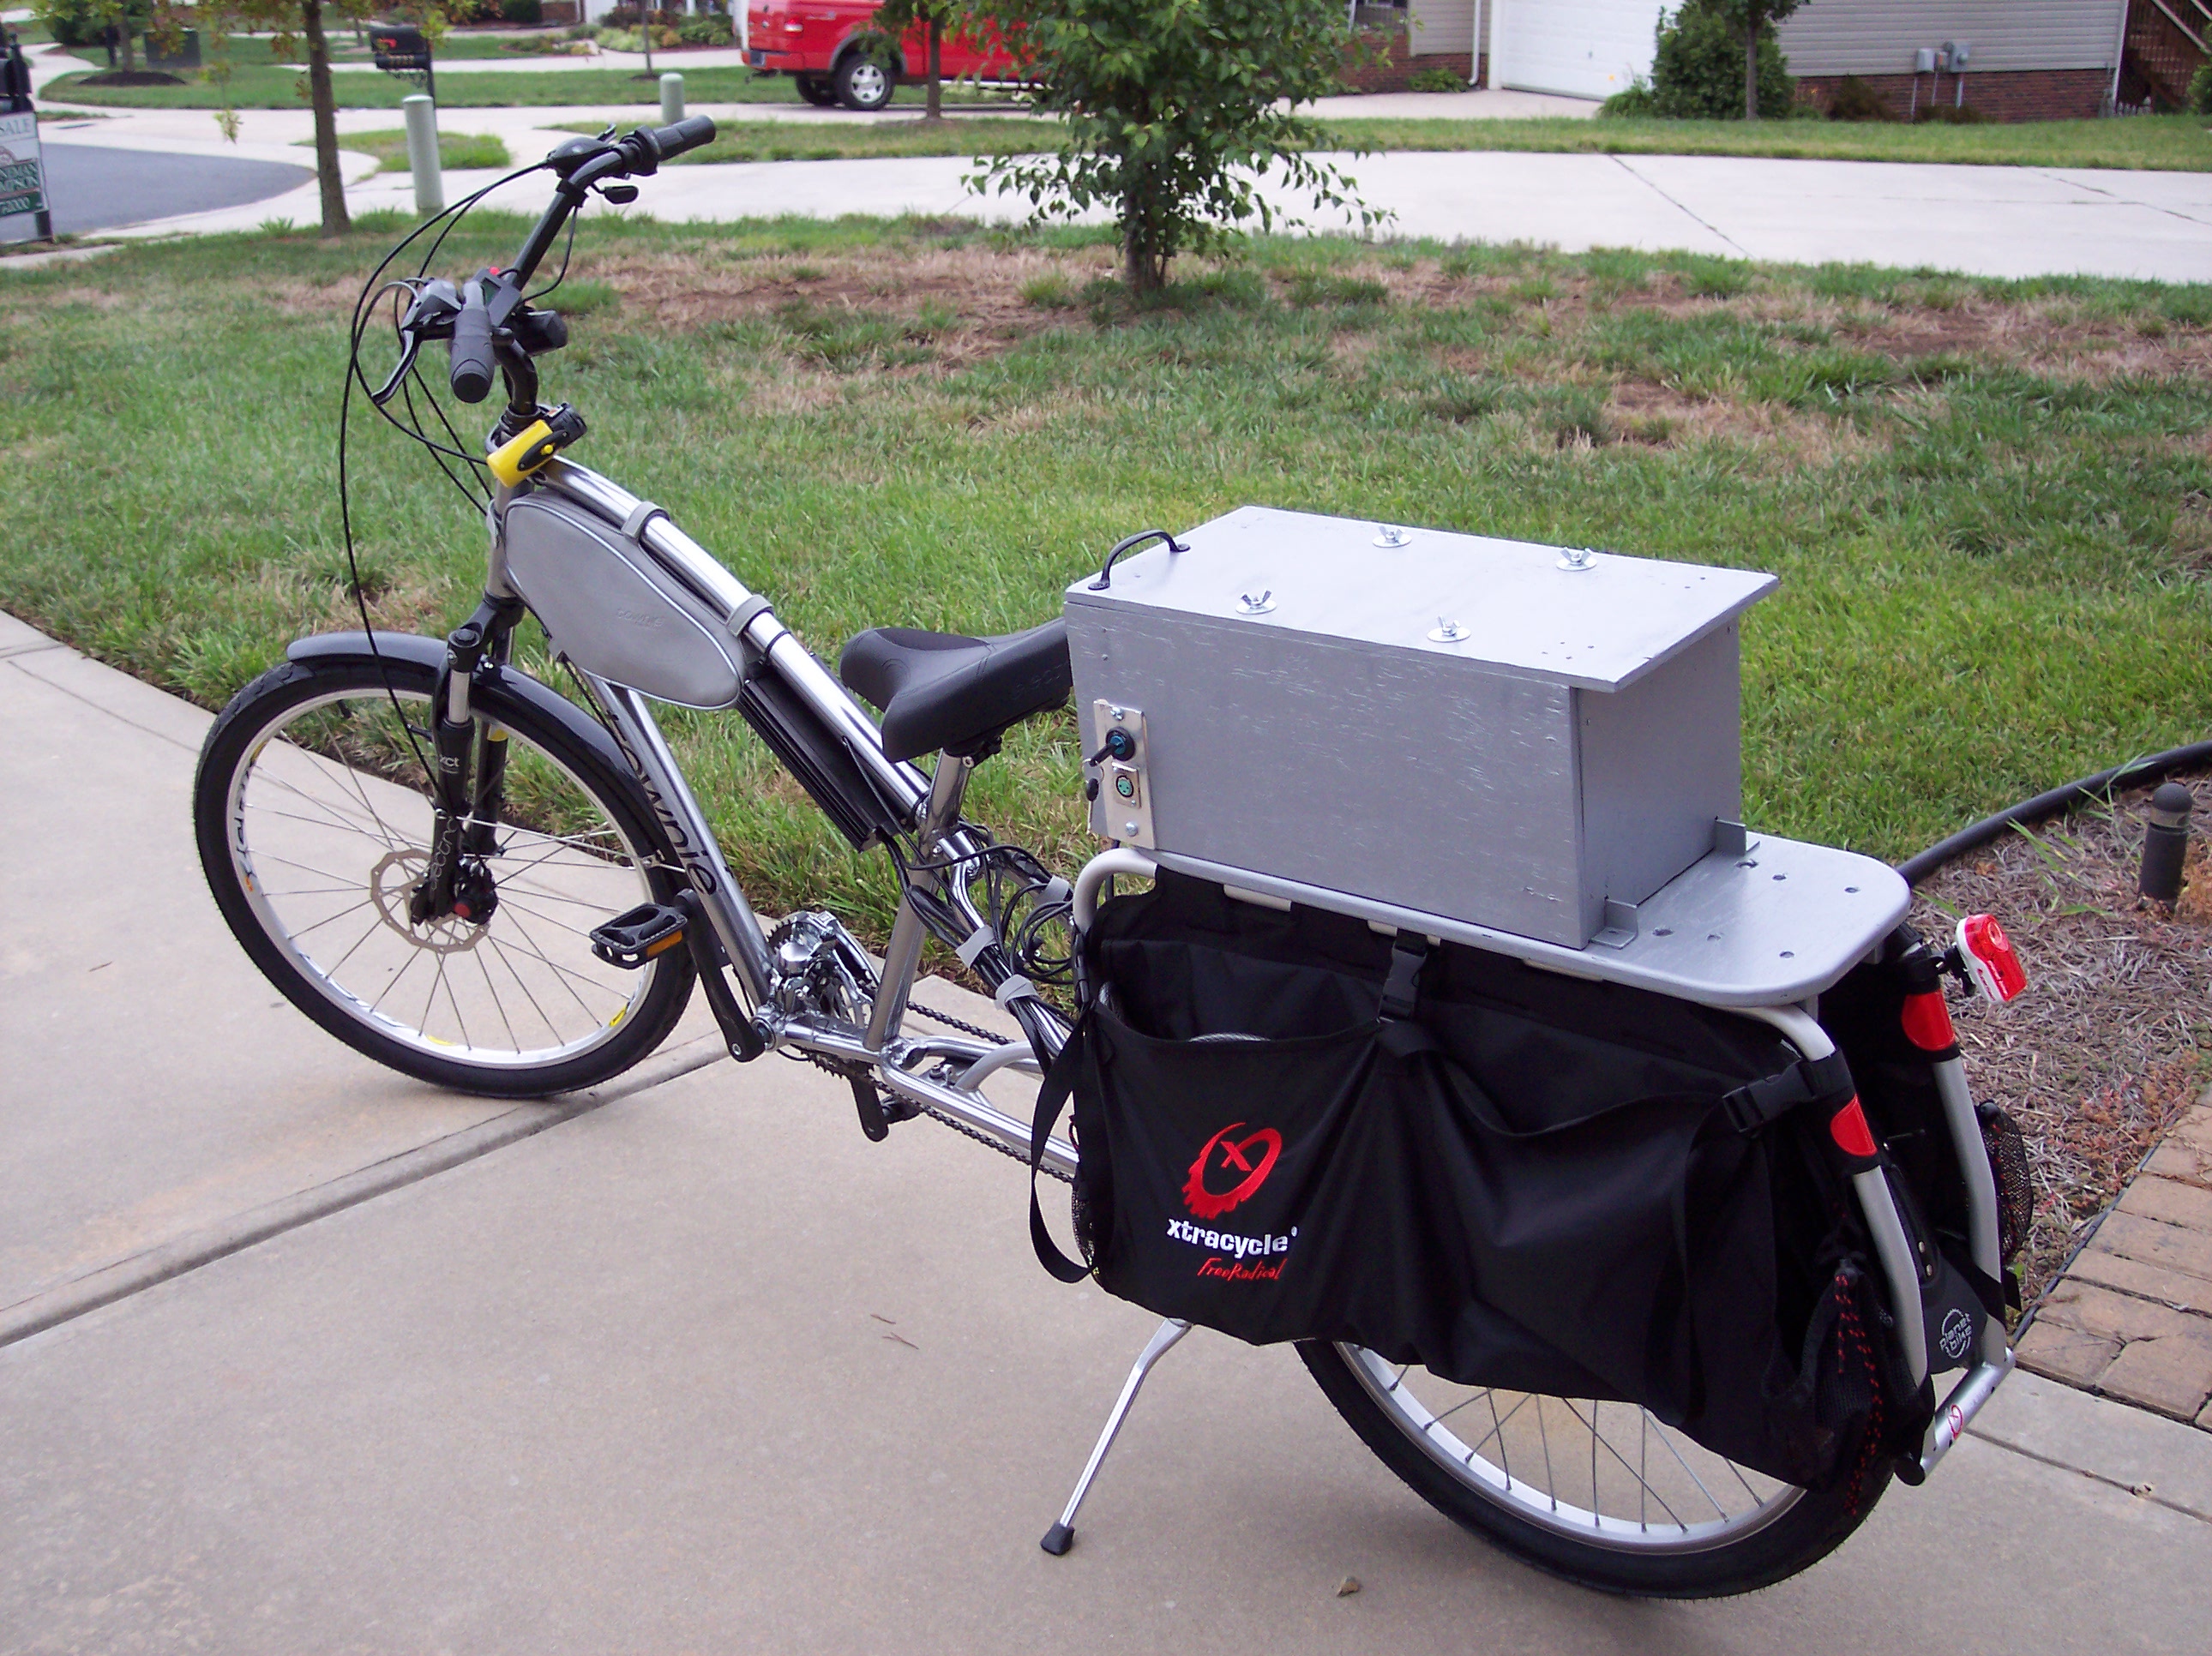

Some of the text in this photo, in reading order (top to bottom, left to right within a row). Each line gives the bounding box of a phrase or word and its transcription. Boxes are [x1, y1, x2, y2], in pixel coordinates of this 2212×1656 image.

[1167, 1218, 1289, 1260] xtracycle
[1939, 1312, 1972, 1352] planet
[1950, 1324, 1973, 1352] bike
